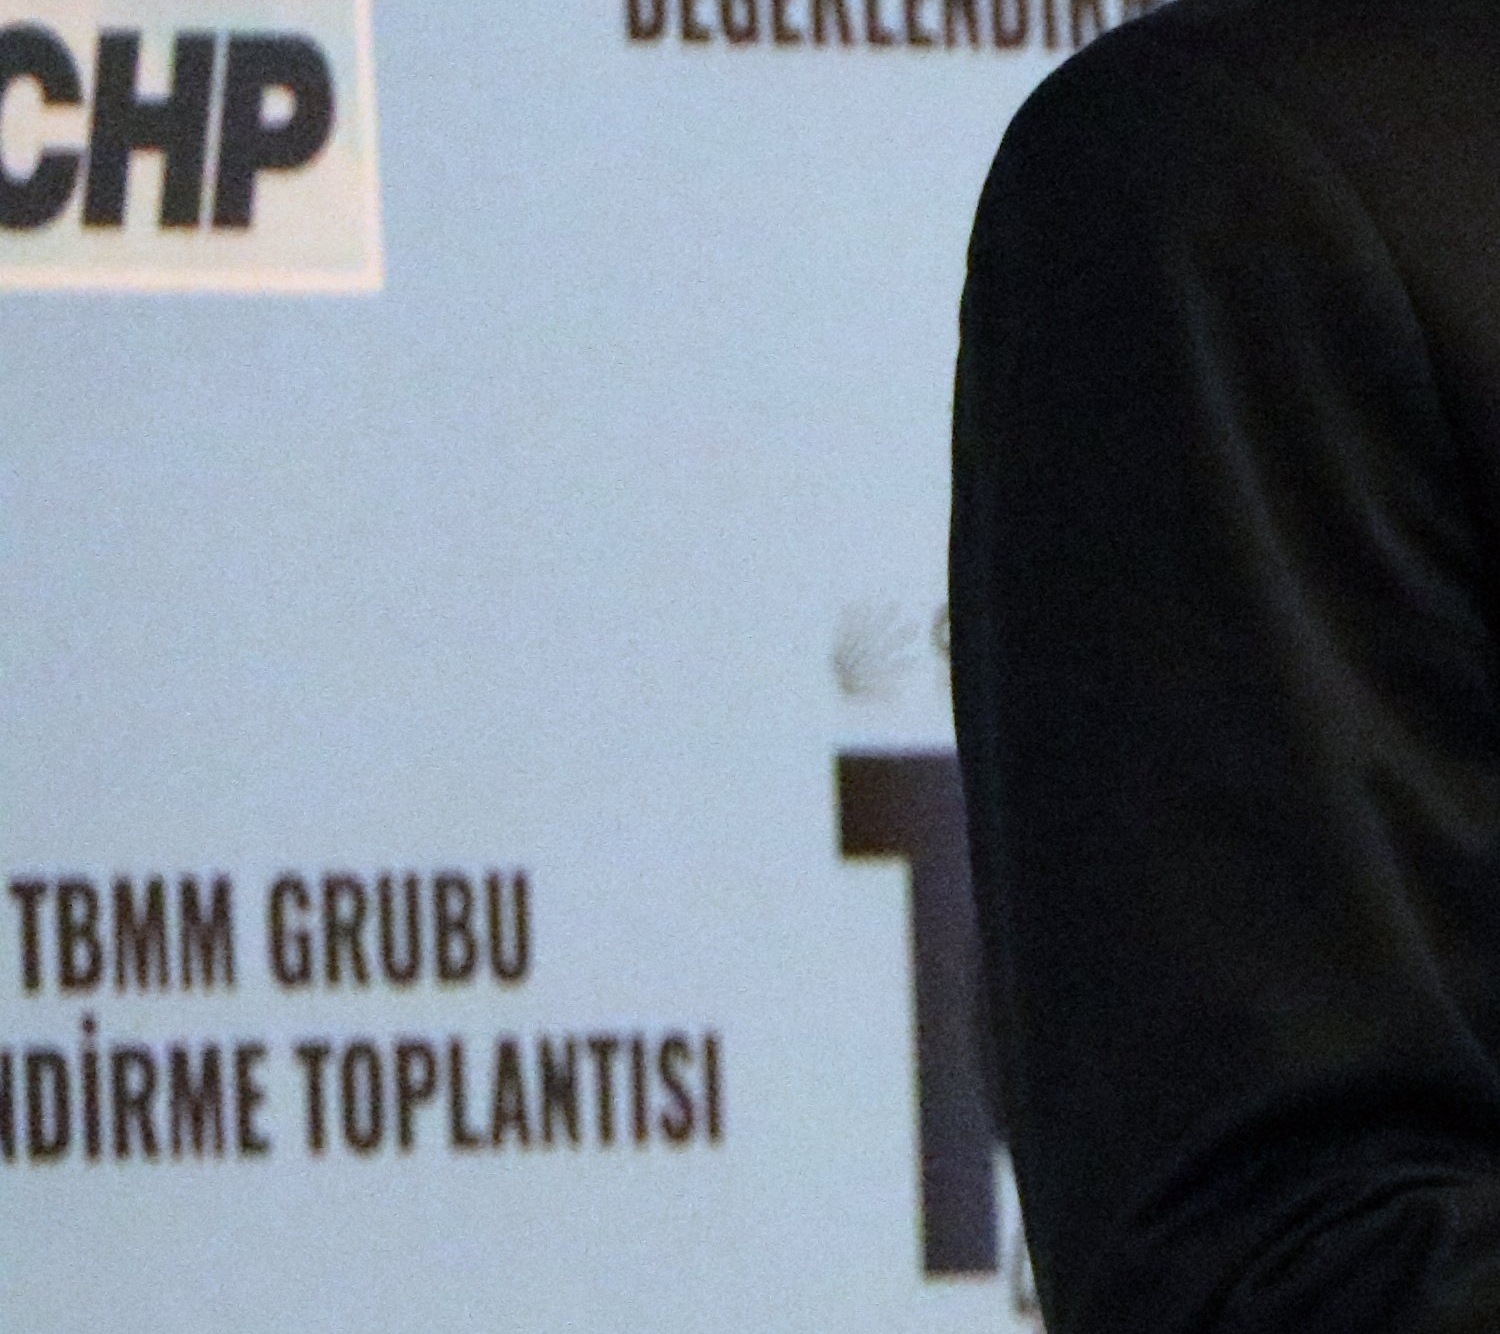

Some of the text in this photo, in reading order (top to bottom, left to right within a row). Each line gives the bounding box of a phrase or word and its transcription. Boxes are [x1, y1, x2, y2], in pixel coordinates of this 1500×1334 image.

[0, 19, 336, 233] CHP
[10, 868, 534, 996] TBMM GRUBU
[295, 1028, 726, 1158] TOPLANTISI
